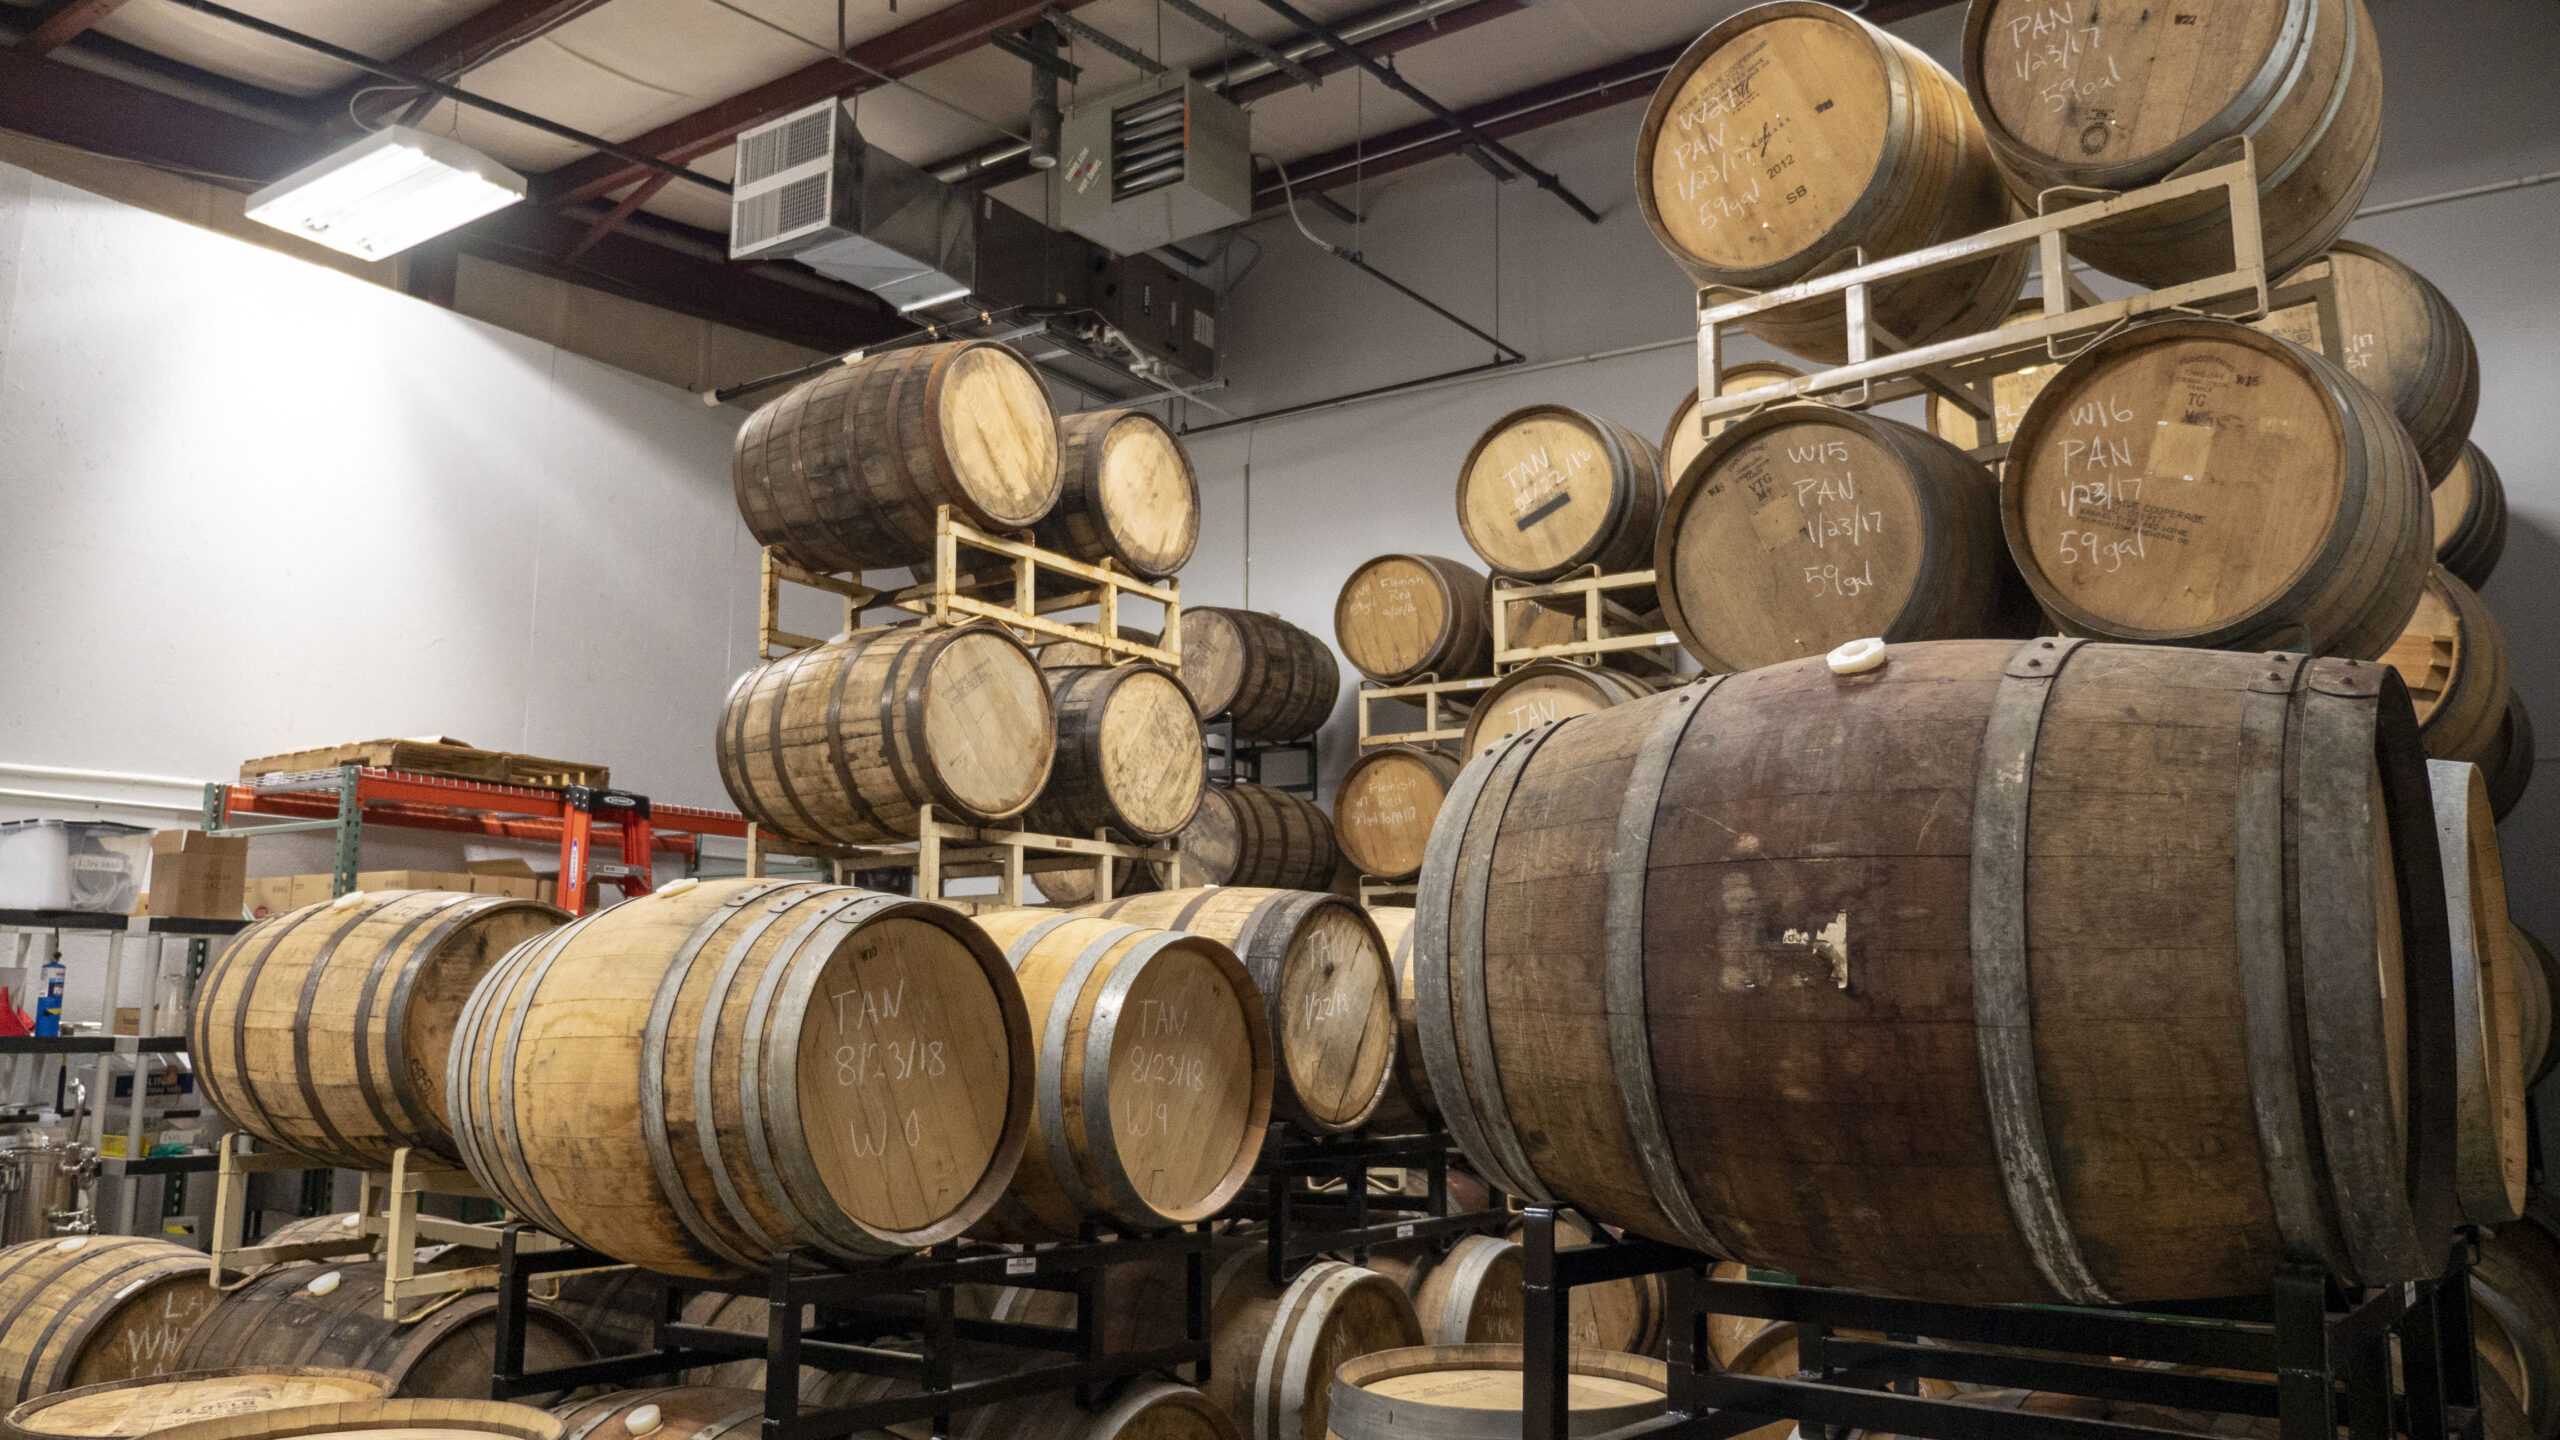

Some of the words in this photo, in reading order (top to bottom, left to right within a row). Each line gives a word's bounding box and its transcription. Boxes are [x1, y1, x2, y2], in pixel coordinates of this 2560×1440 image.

[2006, 1, 2073, 48] PAN
[1675, 121, 1724, 170] PAN
[1766, 154, 1795, 180] 2012
[1786, 184, 1808, 205] SB
[2071, 395, 2134, 428] W16
[1502, 447, 1549, 488] TAN
[1787, 442, 1848, 464] W15
[2058, 435, 2133, 477] PAN
[1793, 472, 1854, 507] PAN
[1808, 504, 1882, 548] 1/23/17
[1508, 698, 1555, 732] TAN
[832, 979, 904, 1035] TAN
[1139, 1000, 1188, 1037] TAN
[1130, 1046, 1204, 1092] 8/23/18
